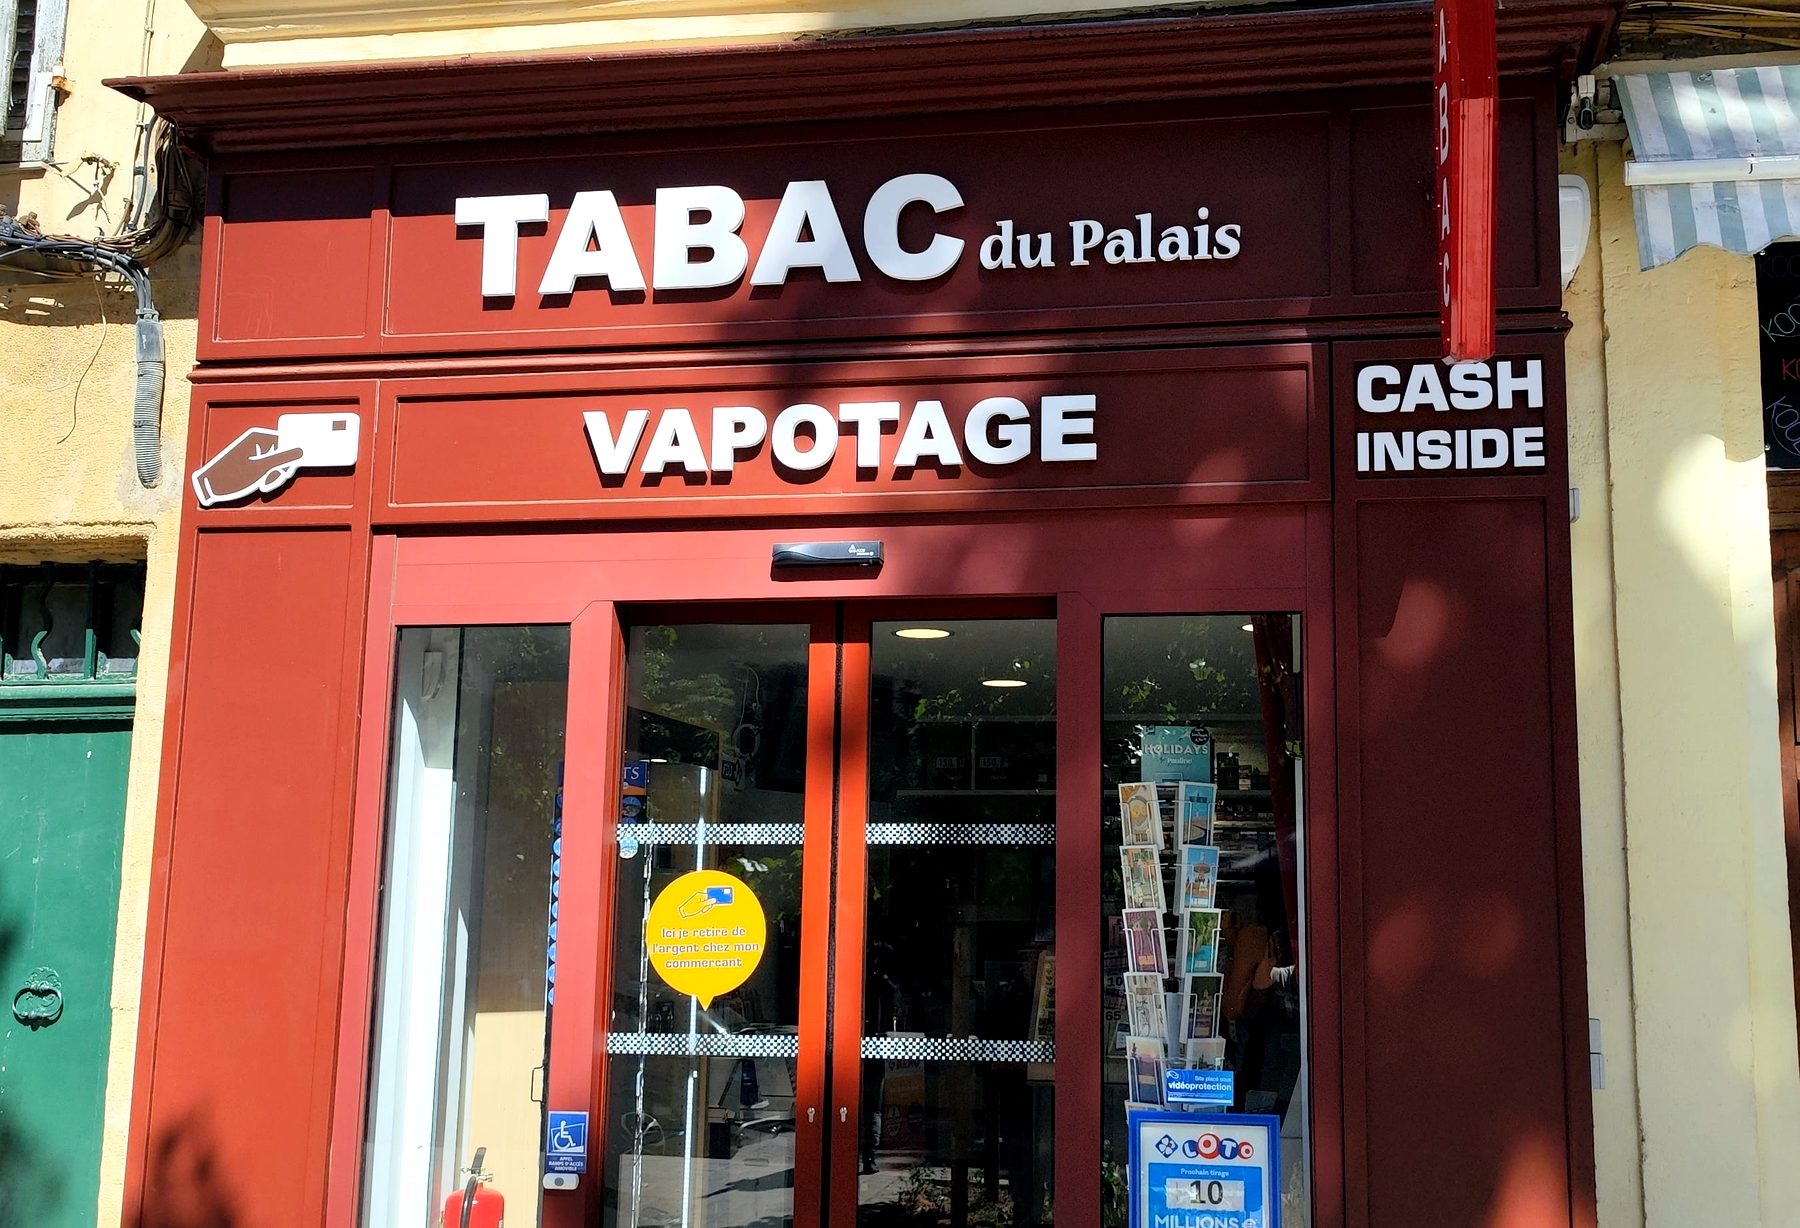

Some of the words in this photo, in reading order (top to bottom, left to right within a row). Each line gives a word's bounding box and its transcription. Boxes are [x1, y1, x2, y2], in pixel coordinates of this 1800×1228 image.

[454, 173, 966, 300] TABAC
[979, 219, 1055, 272] du
[1070, 207, 1243, 267] Palais
[1356, 359, 1544, 414] CASH
[583, 394, 1098, 474] VAPOTAGE
[1356, 426, 1546, 472] INSIDE
[1144, 744, 1208, 755] HOLIDAYS
[661, 927, 676, 938] Ici
[679, 927, 689, 939] je
[692, 926, 728, 937] retire
[731, 926, 746, 936] de
[652, 943, 699, 955] l'argent
[703, 942, 729, 952] chez
[734, 943, 759, 951] mon
[1105, 1011, 1121, 1021] 65
[1168, 1081, 1232, 1091] vidéoprotection
[1182, 1133, 1254, 1160] LOTO
[1180, 1168, 1210, 1176] Prochain
[1210, 1169, 1230, 1178] tirage
[1190, 1180, 1224, 1205] 10
[1154, 1214, 1239, 1228] MILLIONS
